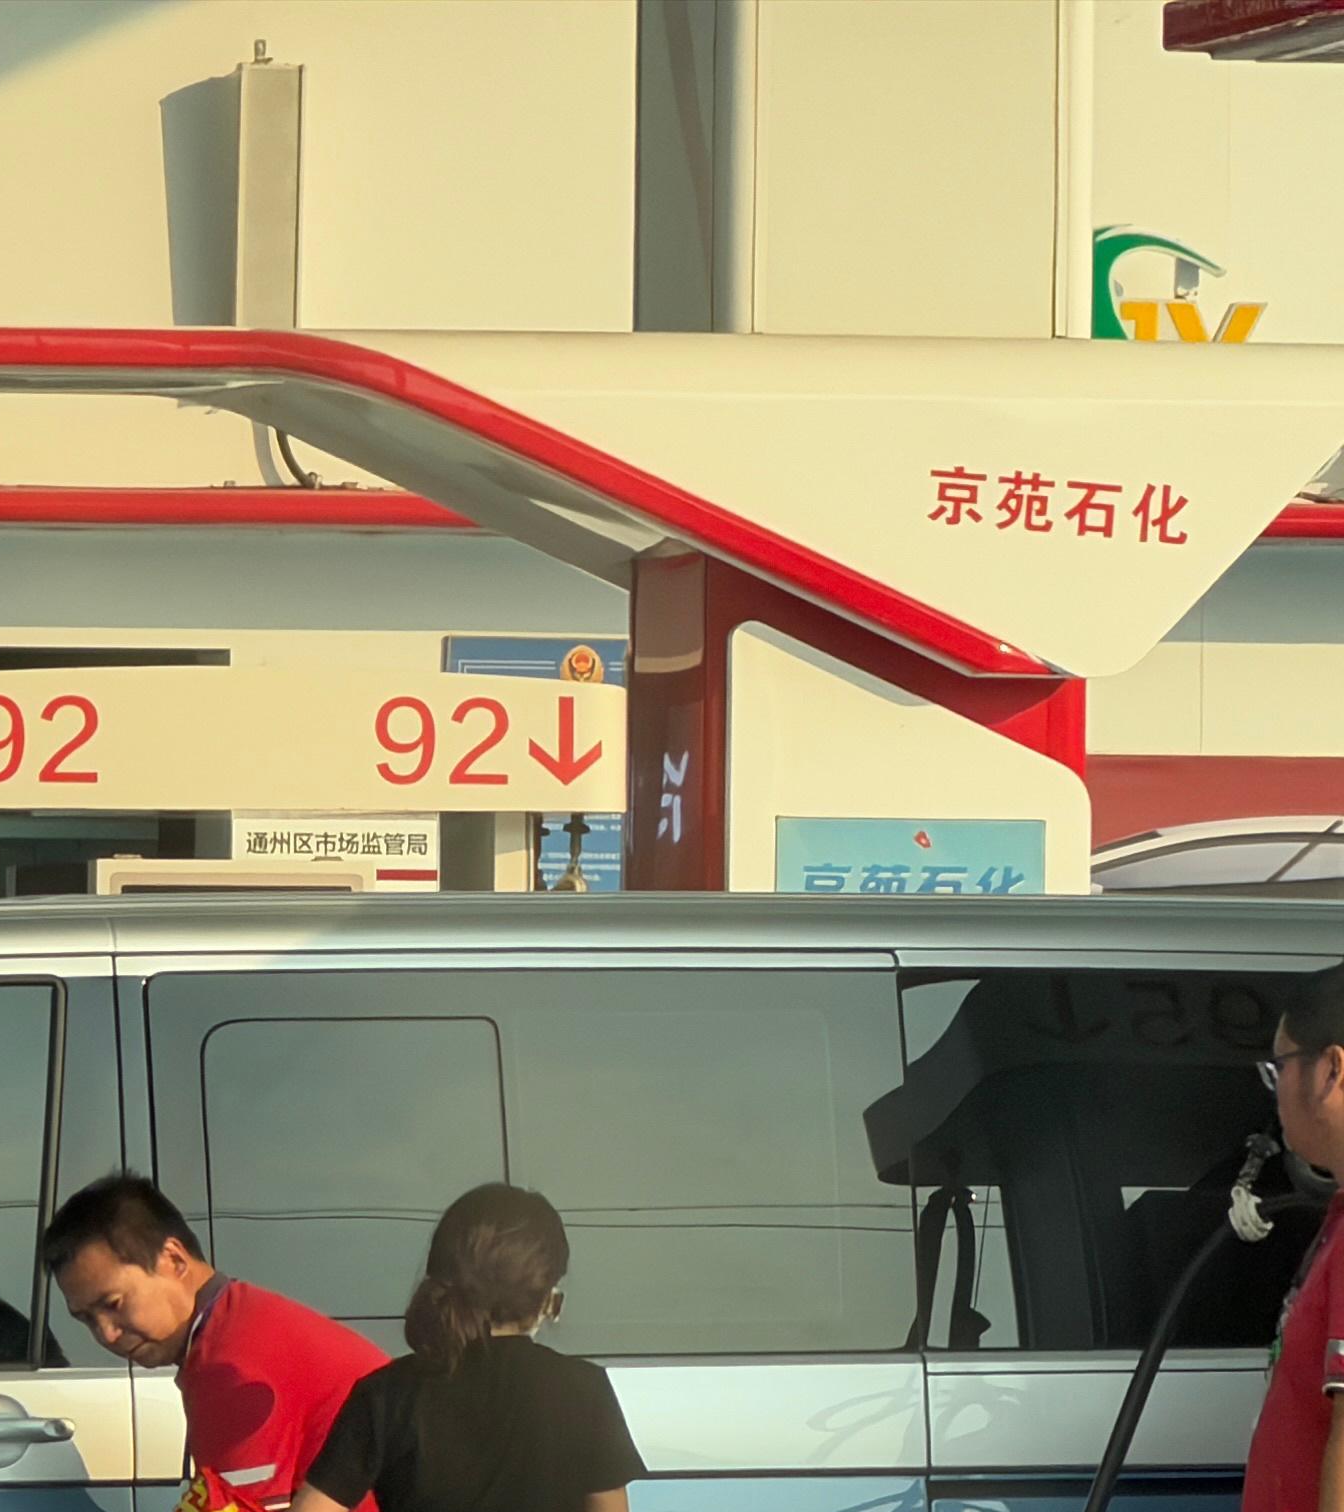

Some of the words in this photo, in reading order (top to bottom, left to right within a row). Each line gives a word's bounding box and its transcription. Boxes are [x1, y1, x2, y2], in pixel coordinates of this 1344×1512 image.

[927, 466, 1189, 545] 京苑石化
[373, 696, 510, 786] 92
[245, 831, 429, 856] 通州区市场监管局
